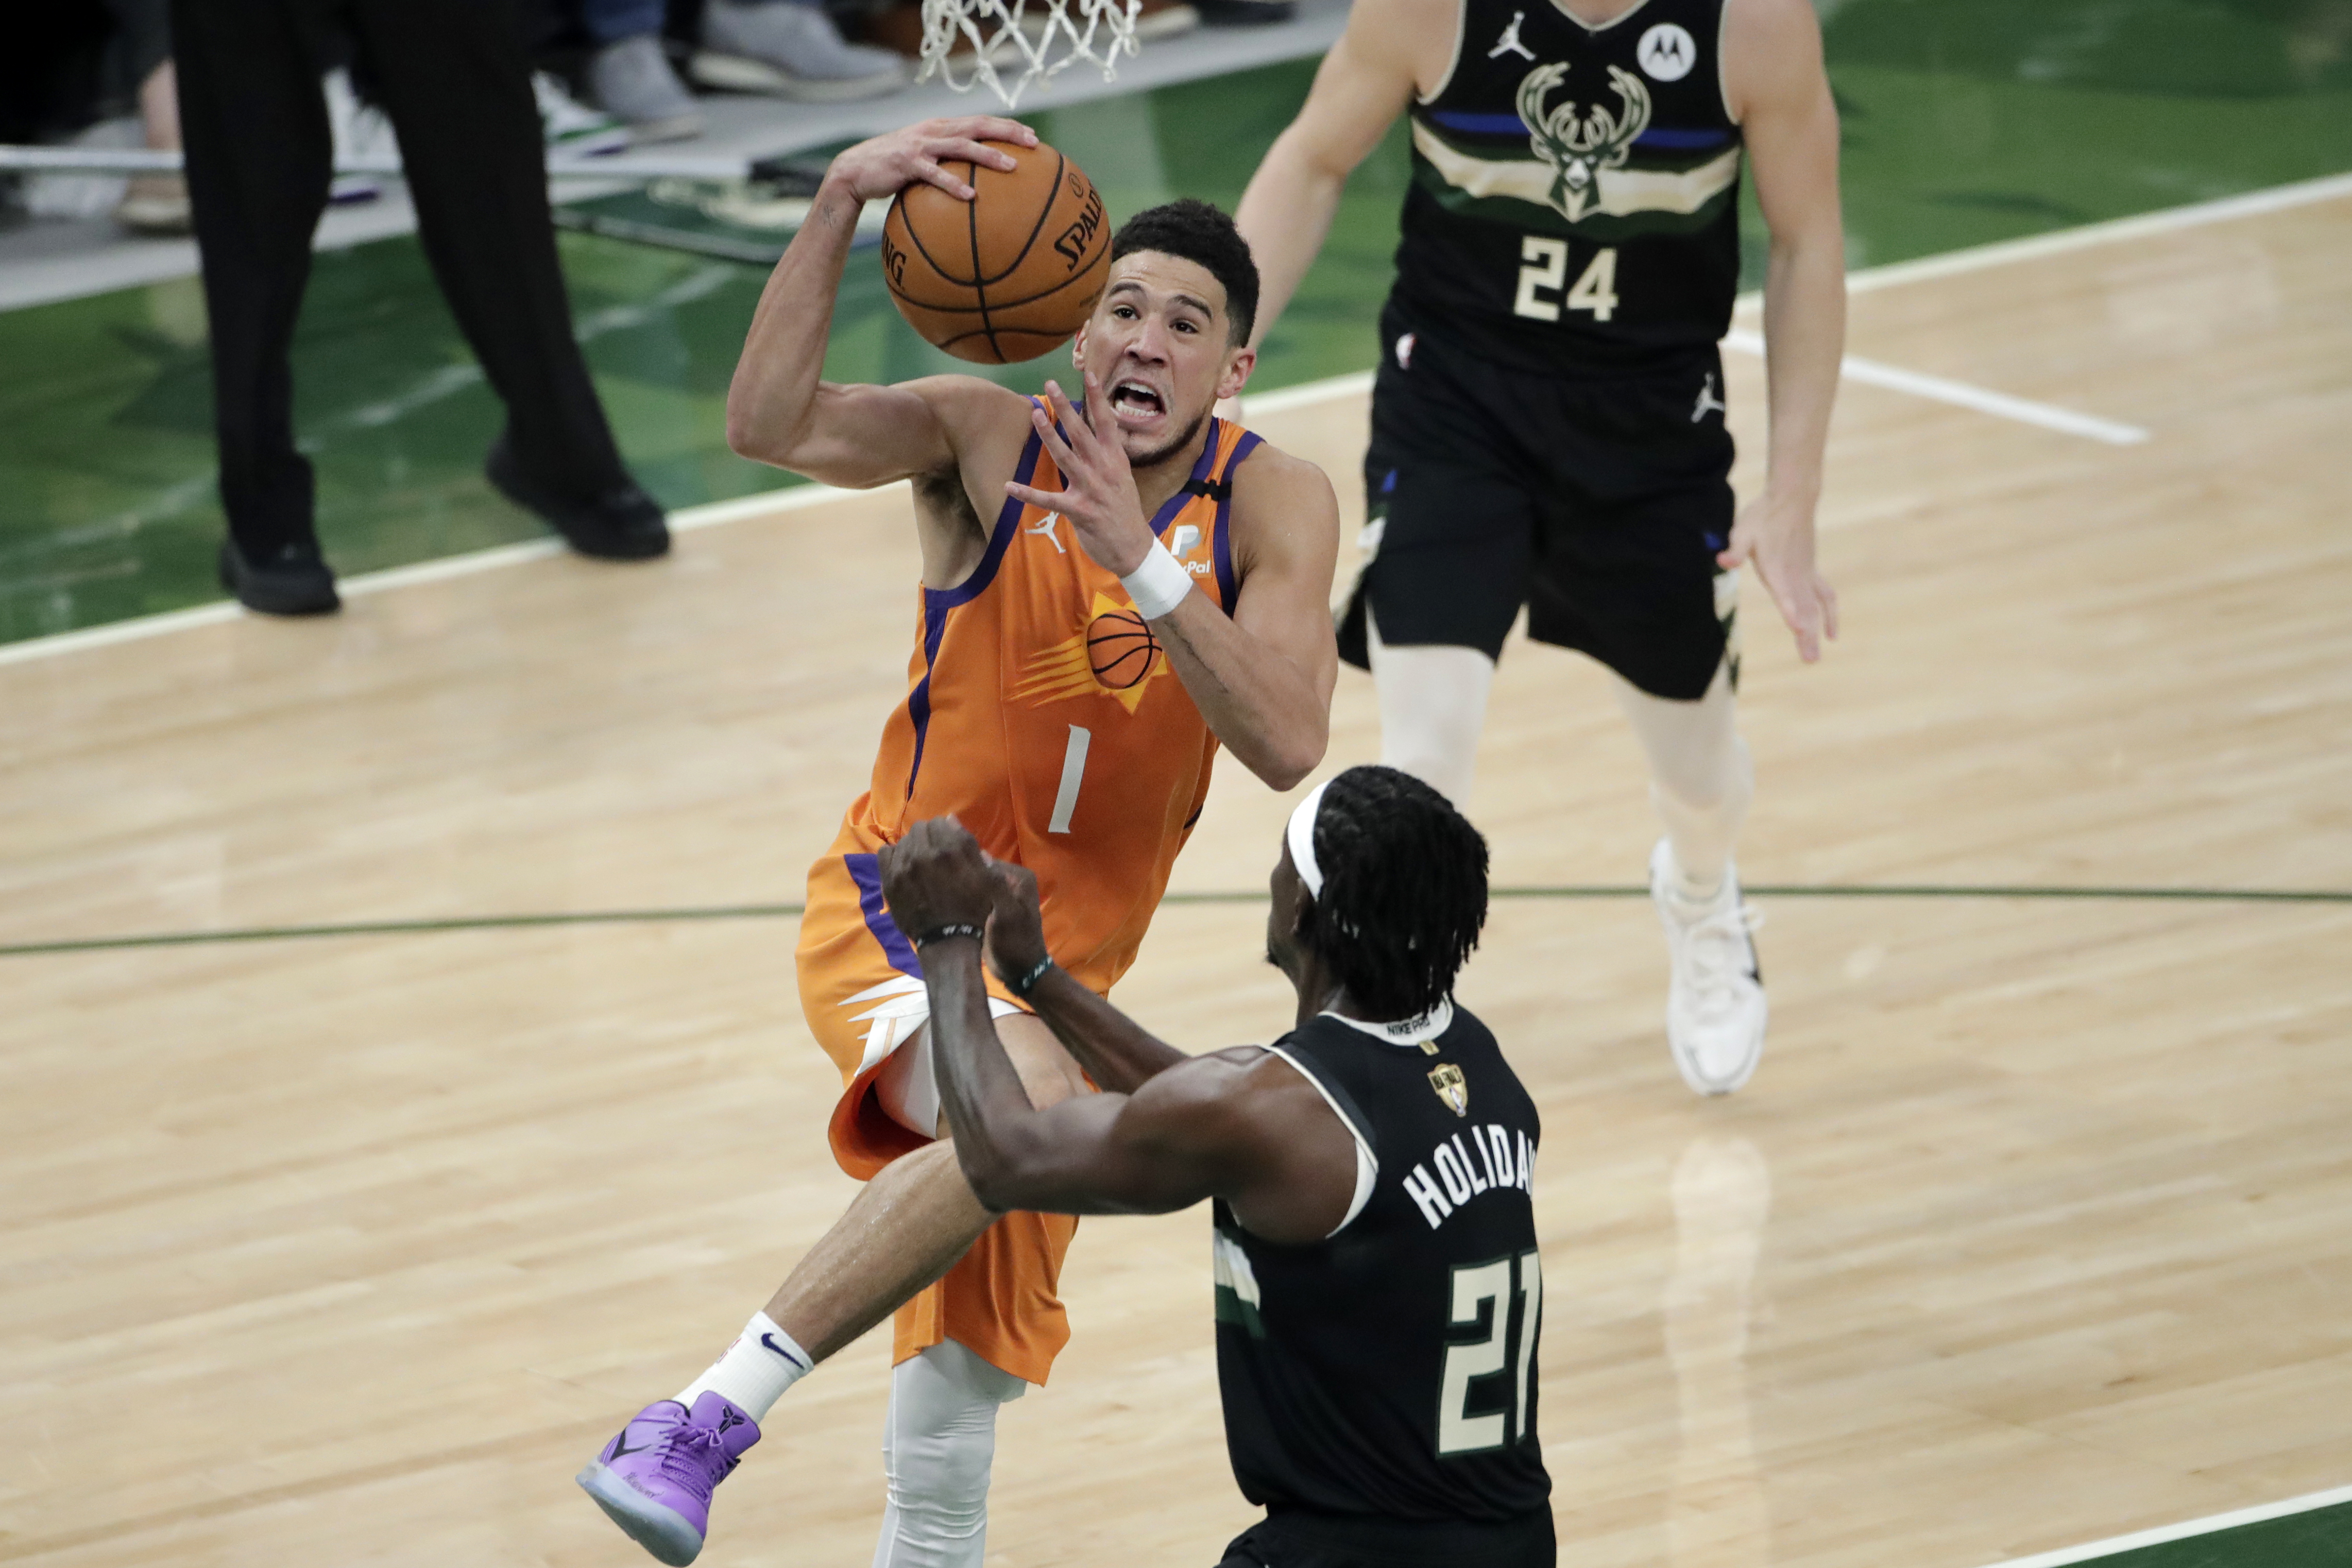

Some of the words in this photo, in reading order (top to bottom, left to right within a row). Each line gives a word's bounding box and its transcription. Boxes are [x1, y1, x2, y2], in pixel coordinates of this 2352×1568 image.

[1054, 181, 1102, 272] SPALD
[1514, 235, 1618, 322] 24
[1183, 559, 1211, 573] Pal
[1048, 723, 1091, 834] 1
[1386, 1022, 1411, 1036] NIKE
[1412, 1017, 1430, 1032] PRO
[1438, 1251, 1541, 1455] 21
